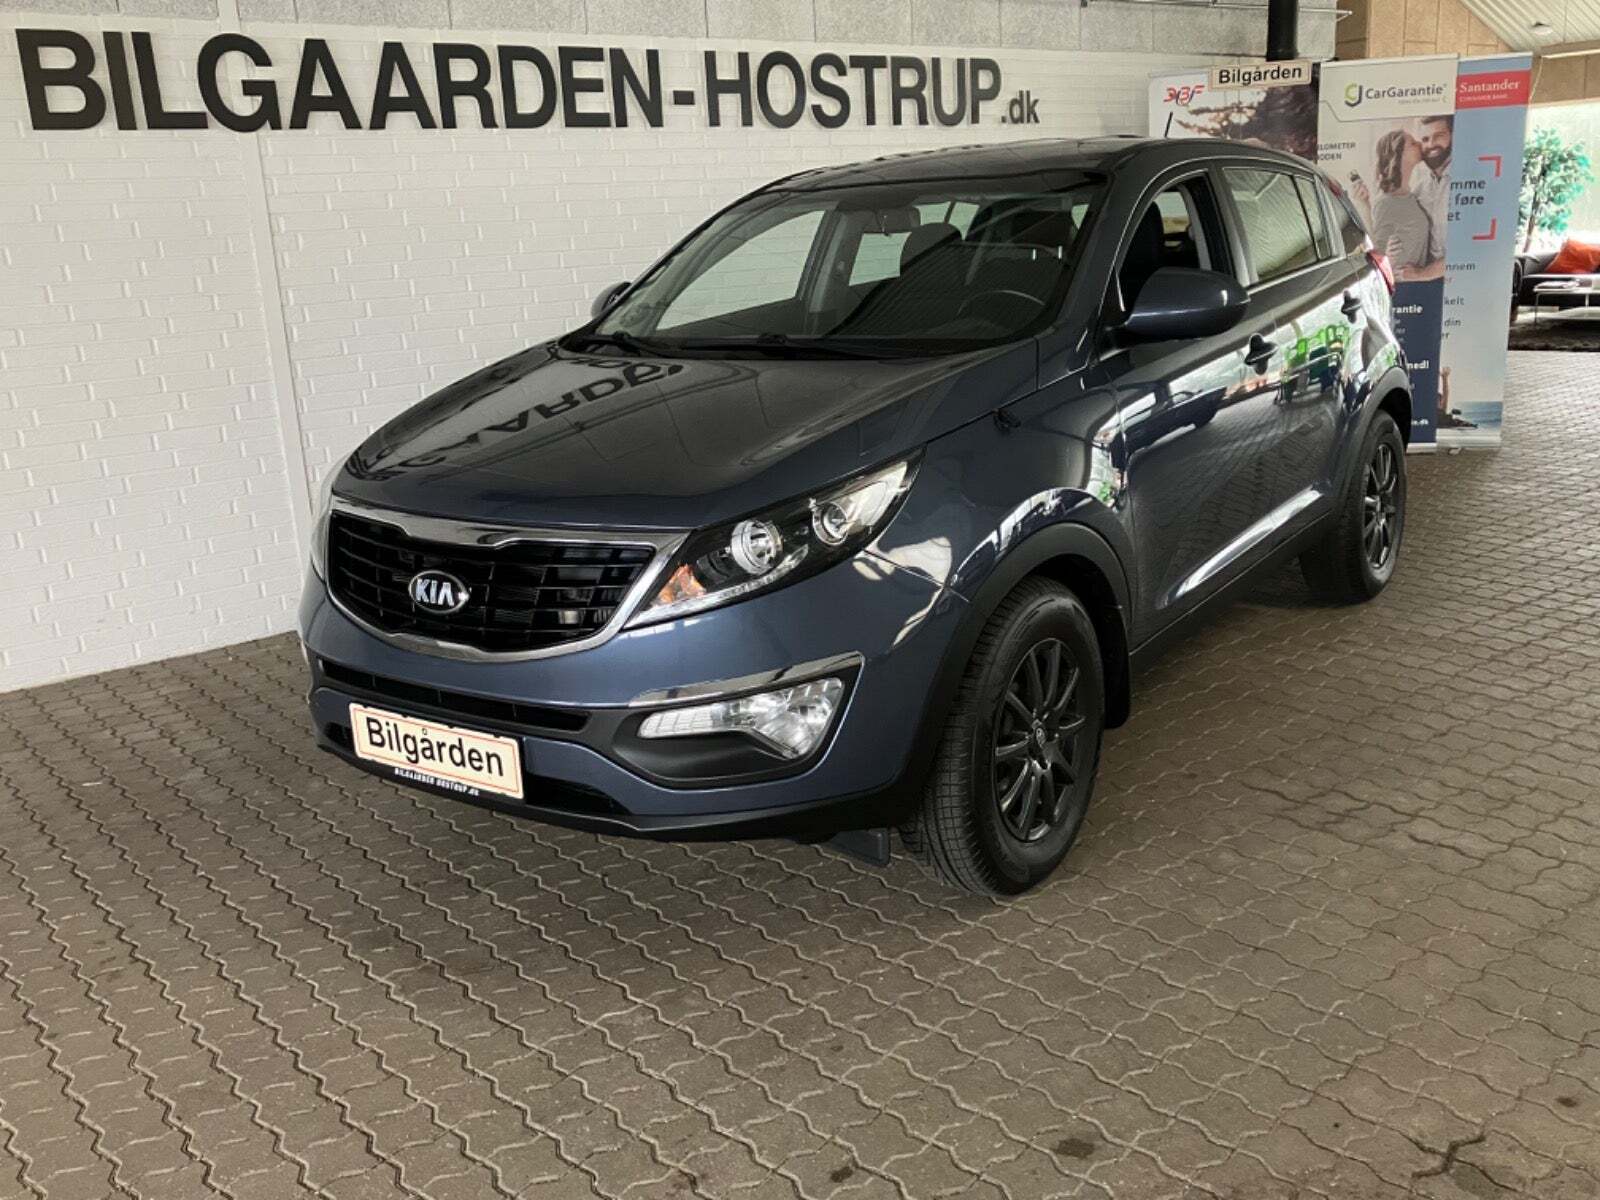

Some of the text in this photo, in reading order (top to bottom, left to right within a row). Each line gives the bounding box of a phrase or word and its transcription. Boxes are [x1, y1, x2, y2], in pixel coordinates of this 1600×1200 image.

[1218, 66, 1302, 86] Bilgården
[1365, 83, 1443, 100] CarGarantie
[1459, 80, 1520, 92] Santander
[1451, 180, 1486, 190] mme
[1455, 193, 1485, 205] føre
[1445, 263, 1476, 271] nnem
[1391, 305, 1424, 314] rantie
[415, 578, 455, 607] KIA
[366, 716, 504, 777] Bilgården
